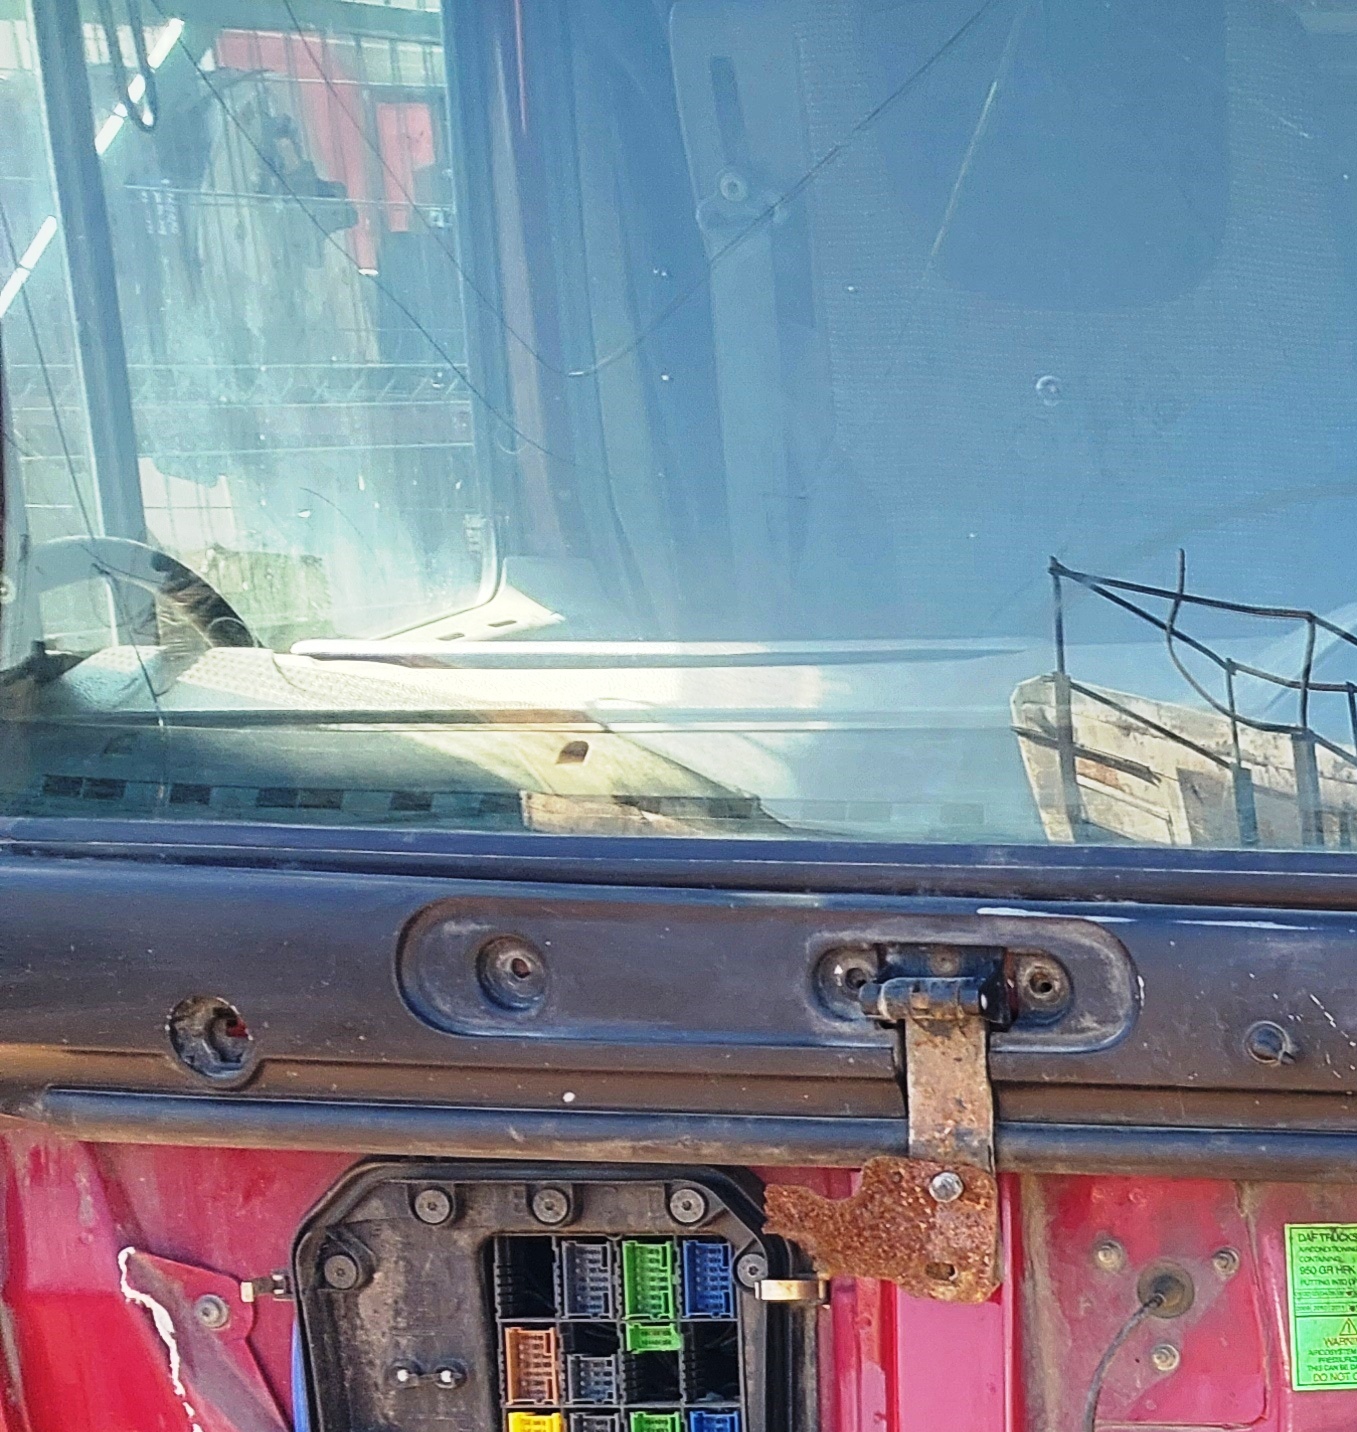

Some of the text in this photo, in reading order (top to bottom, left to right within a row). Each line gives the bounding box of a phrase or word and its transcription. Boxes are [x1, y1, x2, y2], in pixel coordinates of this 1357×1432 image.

[1297, 1232, 1318, 1242] DAF
[1299, 1266, 1317, 1275] 950
[1318, 1265, 1333, 1275] GR
[1313, 1373, 1328, 1382] DO
[1330, 1372, 1351, 1381] NOT
